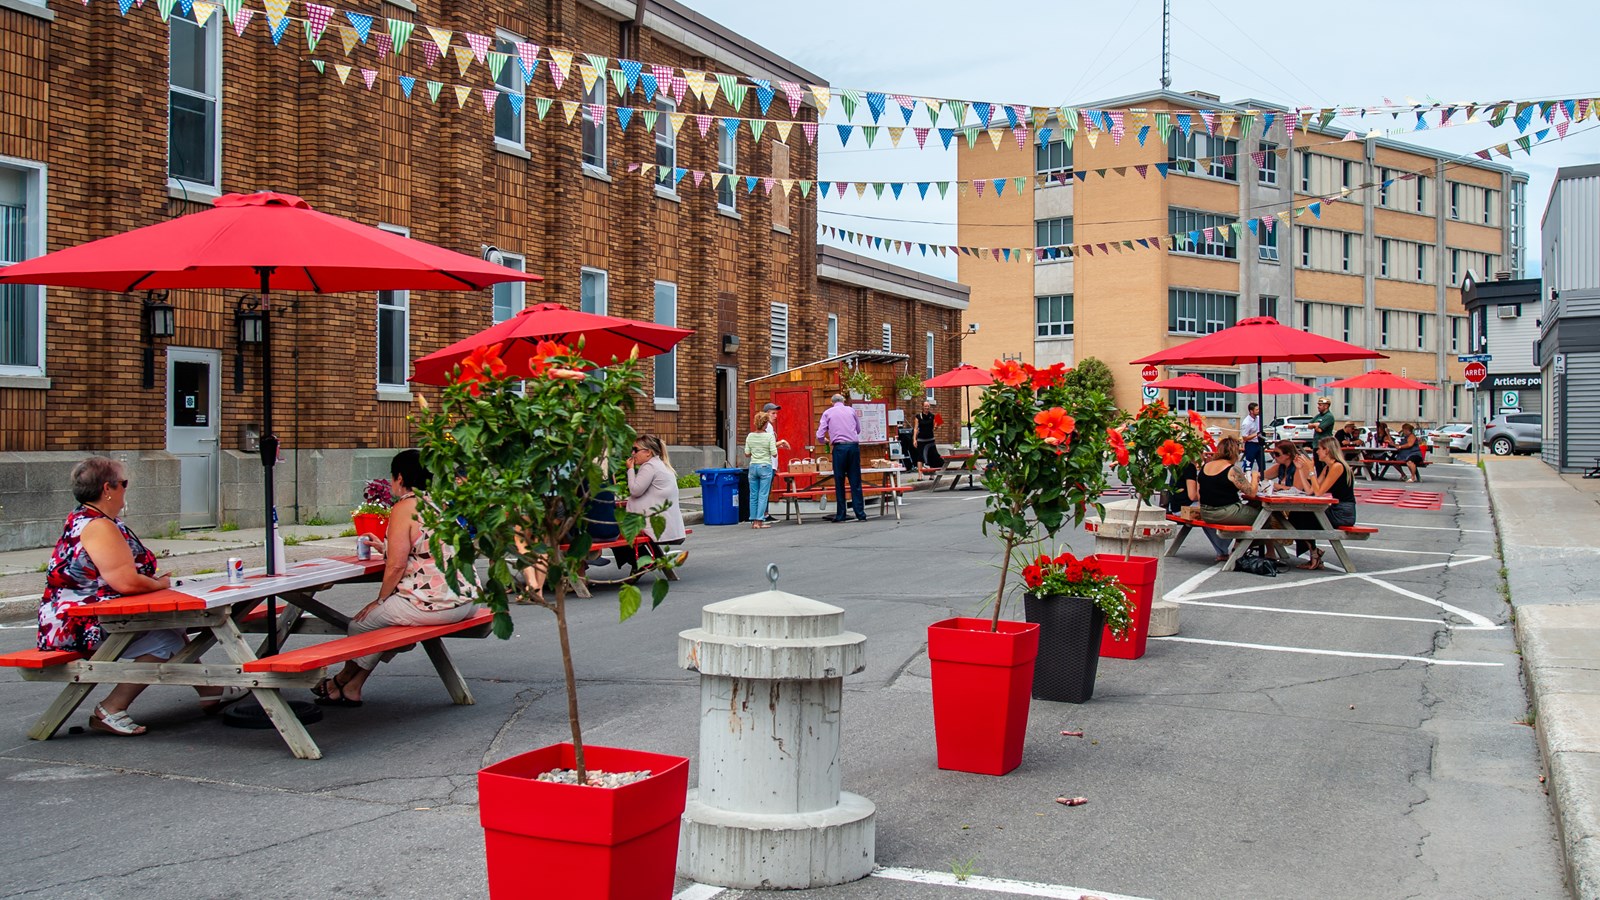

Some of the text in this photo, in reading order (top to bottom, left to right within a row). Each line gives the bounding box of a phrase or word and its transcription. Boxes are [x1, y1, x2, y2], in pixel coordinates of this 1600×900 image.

[1557, 356, 1562, 364] P
[1465, 368, 1485, 376] ARRÊT
[1493, 377, 1527, 386] Articles
